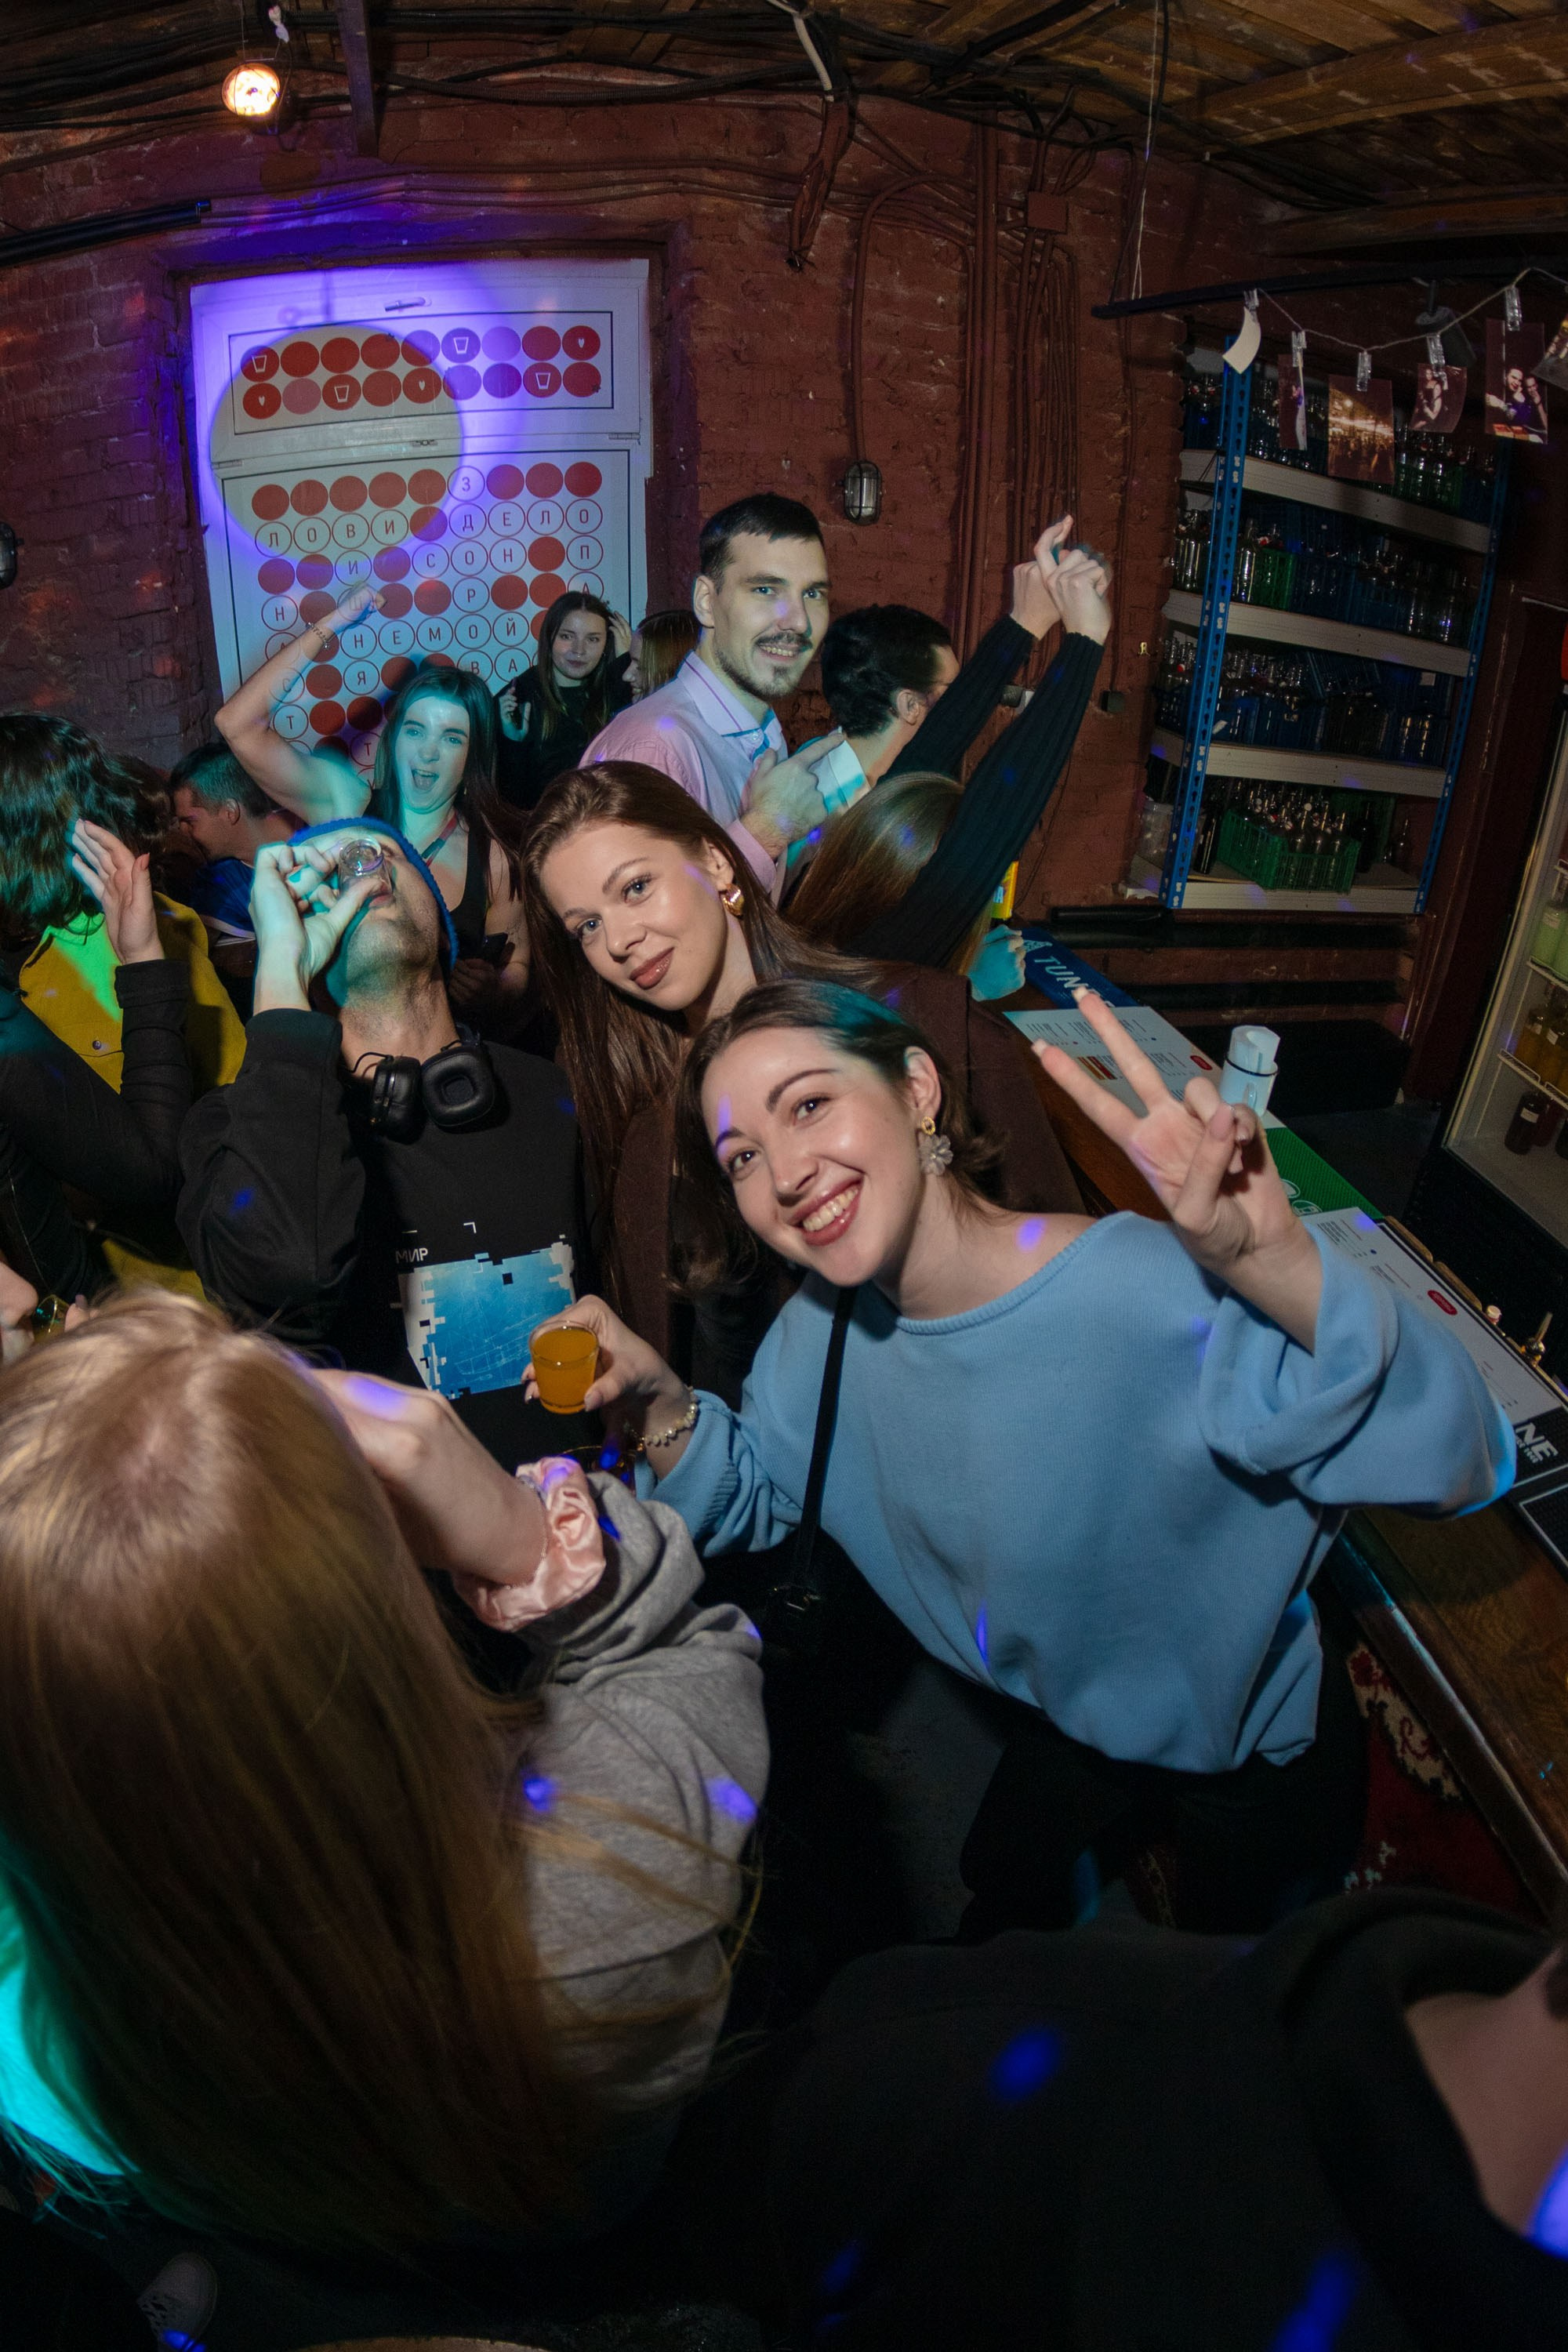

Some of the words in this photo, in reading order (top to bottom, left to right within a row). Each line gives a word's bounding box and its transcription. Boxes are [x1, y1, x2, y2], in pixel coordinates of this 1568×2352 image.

[268, 519, 395, 547] ЛОВИ
[461, 508, 589, 531] ДЕЛО
[426, 544, 514, 569] СОН
[354, 618, 517, 649] НЕМОЙ
[395, 1247, 429, 1265] МИР
